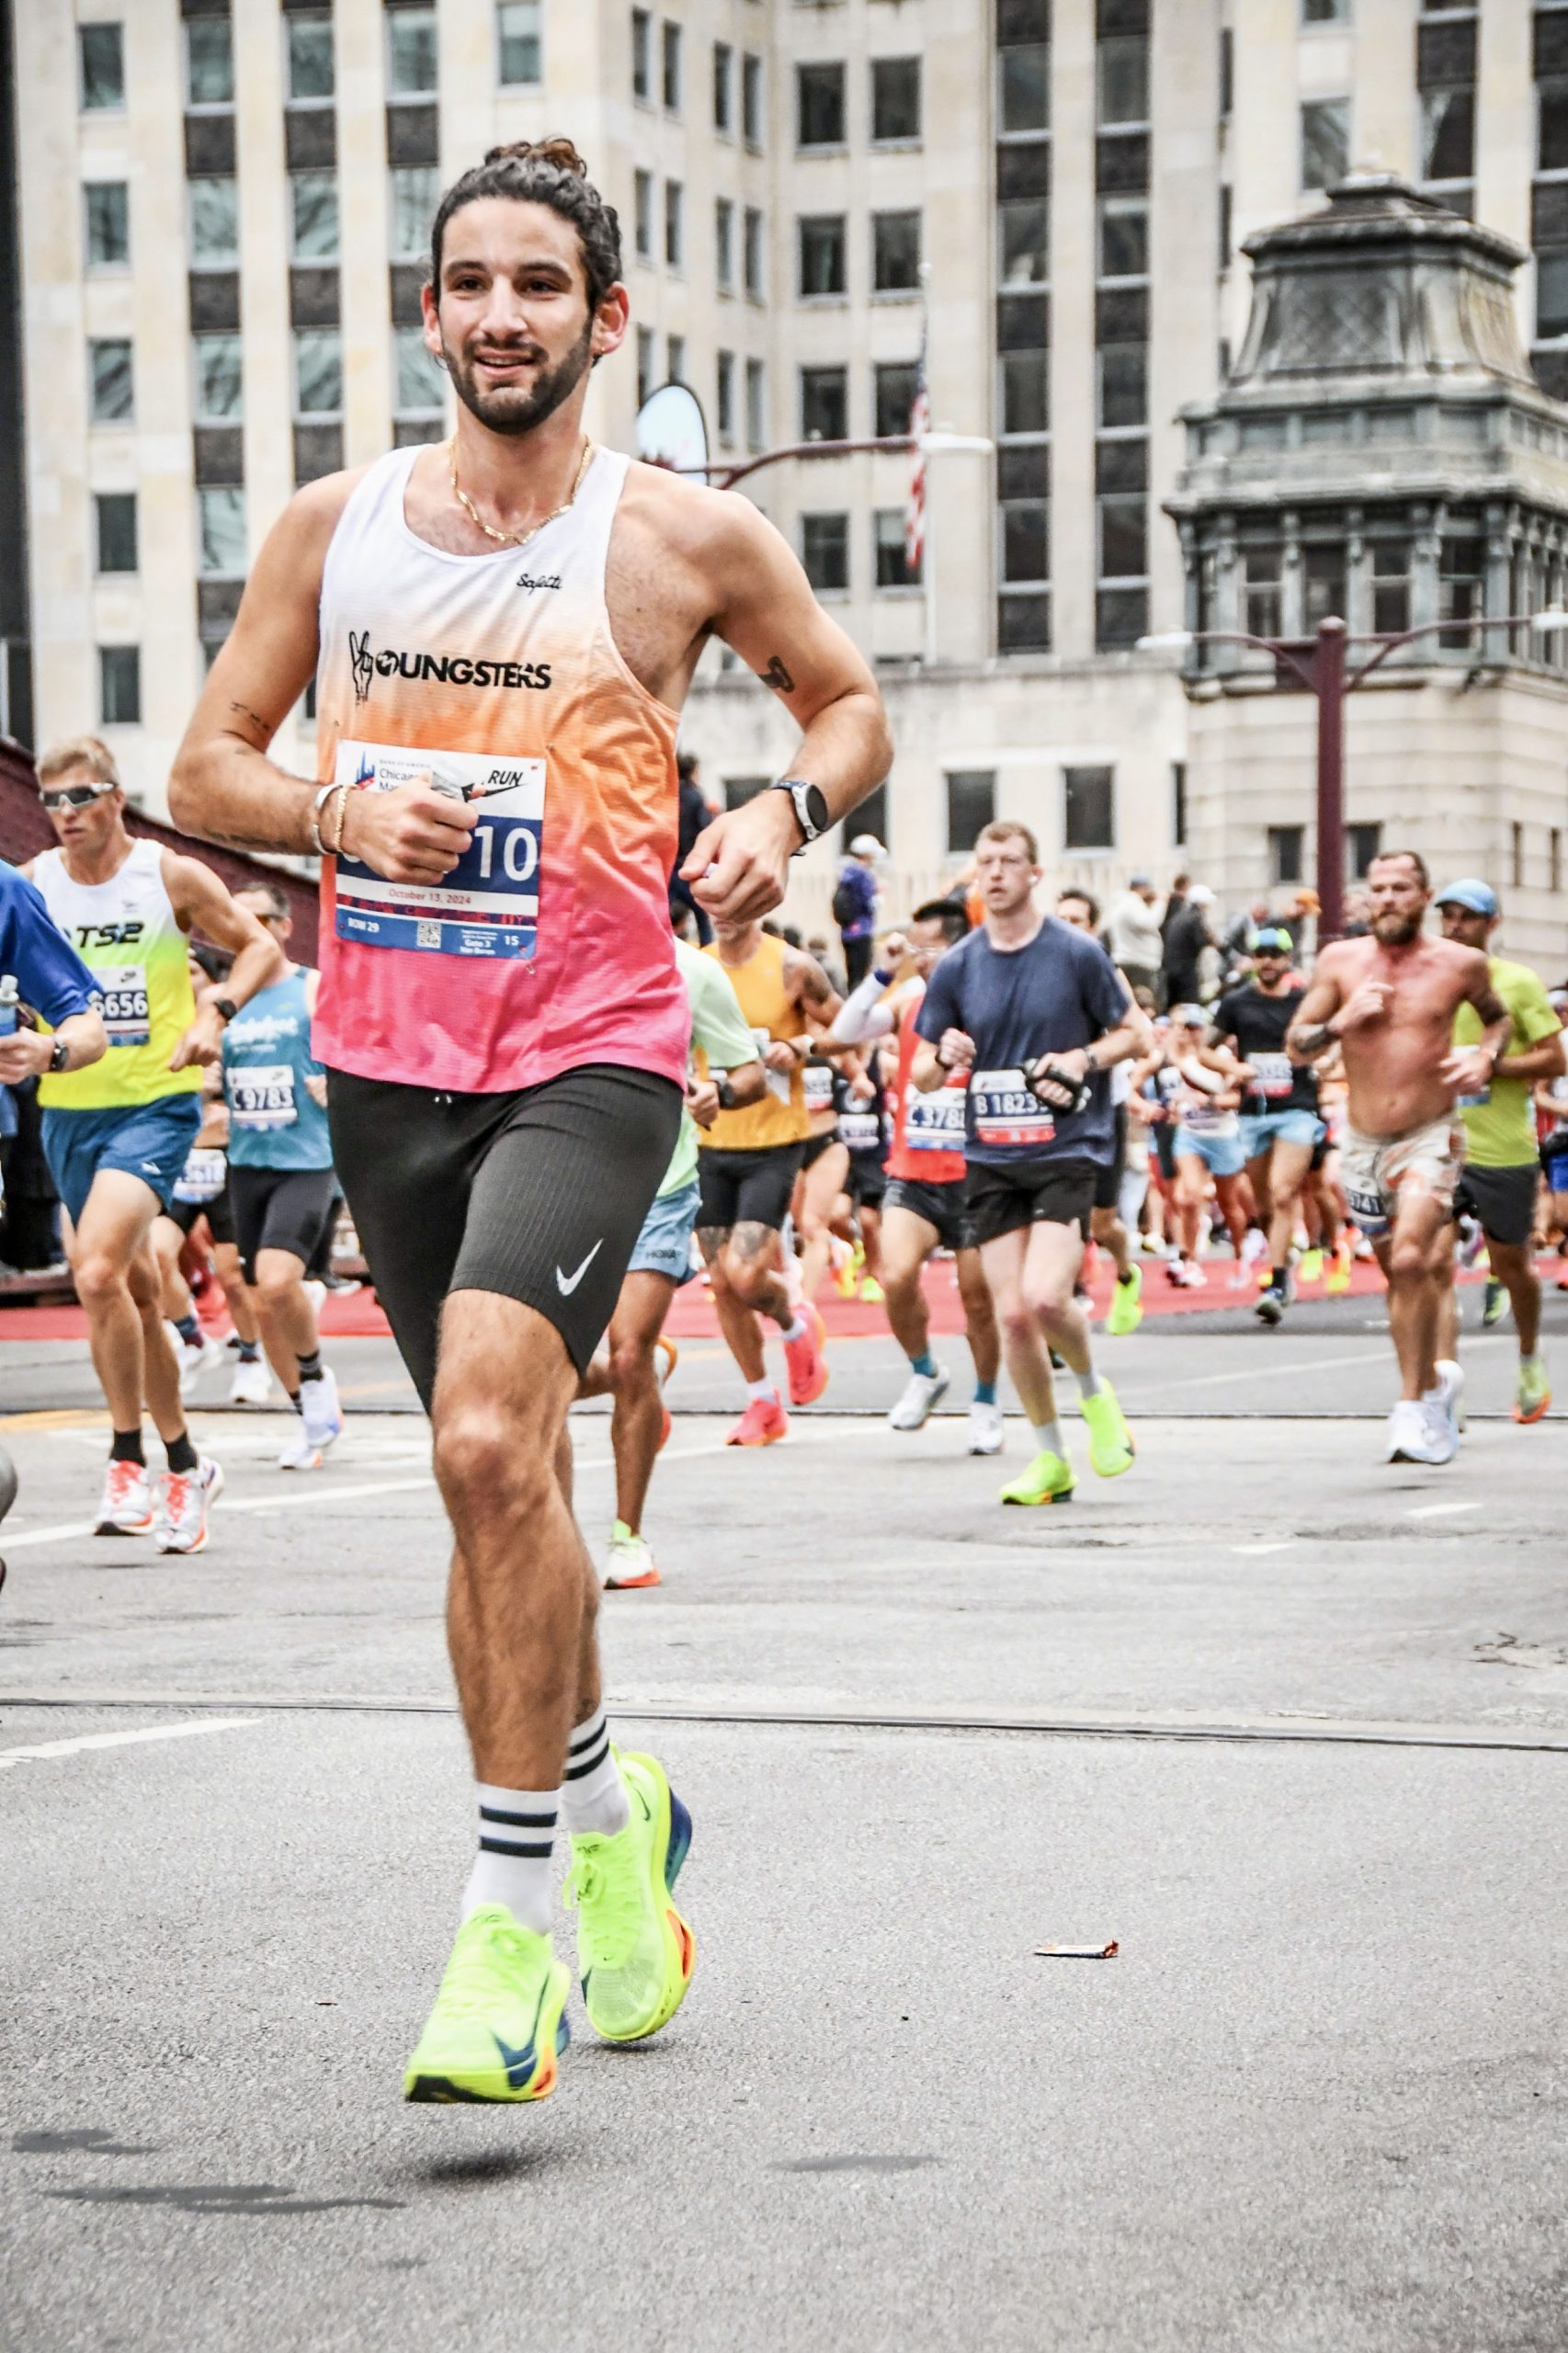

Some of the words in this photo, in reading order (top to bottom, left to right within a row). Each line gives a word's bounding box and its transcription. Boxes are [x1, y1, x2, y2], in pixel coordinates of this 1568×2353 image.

[487, 770, 523, 786] RUN
[474, 825, 538, 881] 10
[389, 889, 425, 900] October
[446, 894, 472, 904] 2024
[63, 923, 143, 948] TS2
[504, 936, 520, 946] 15
[243, 1087, 293, 1109] 9783
